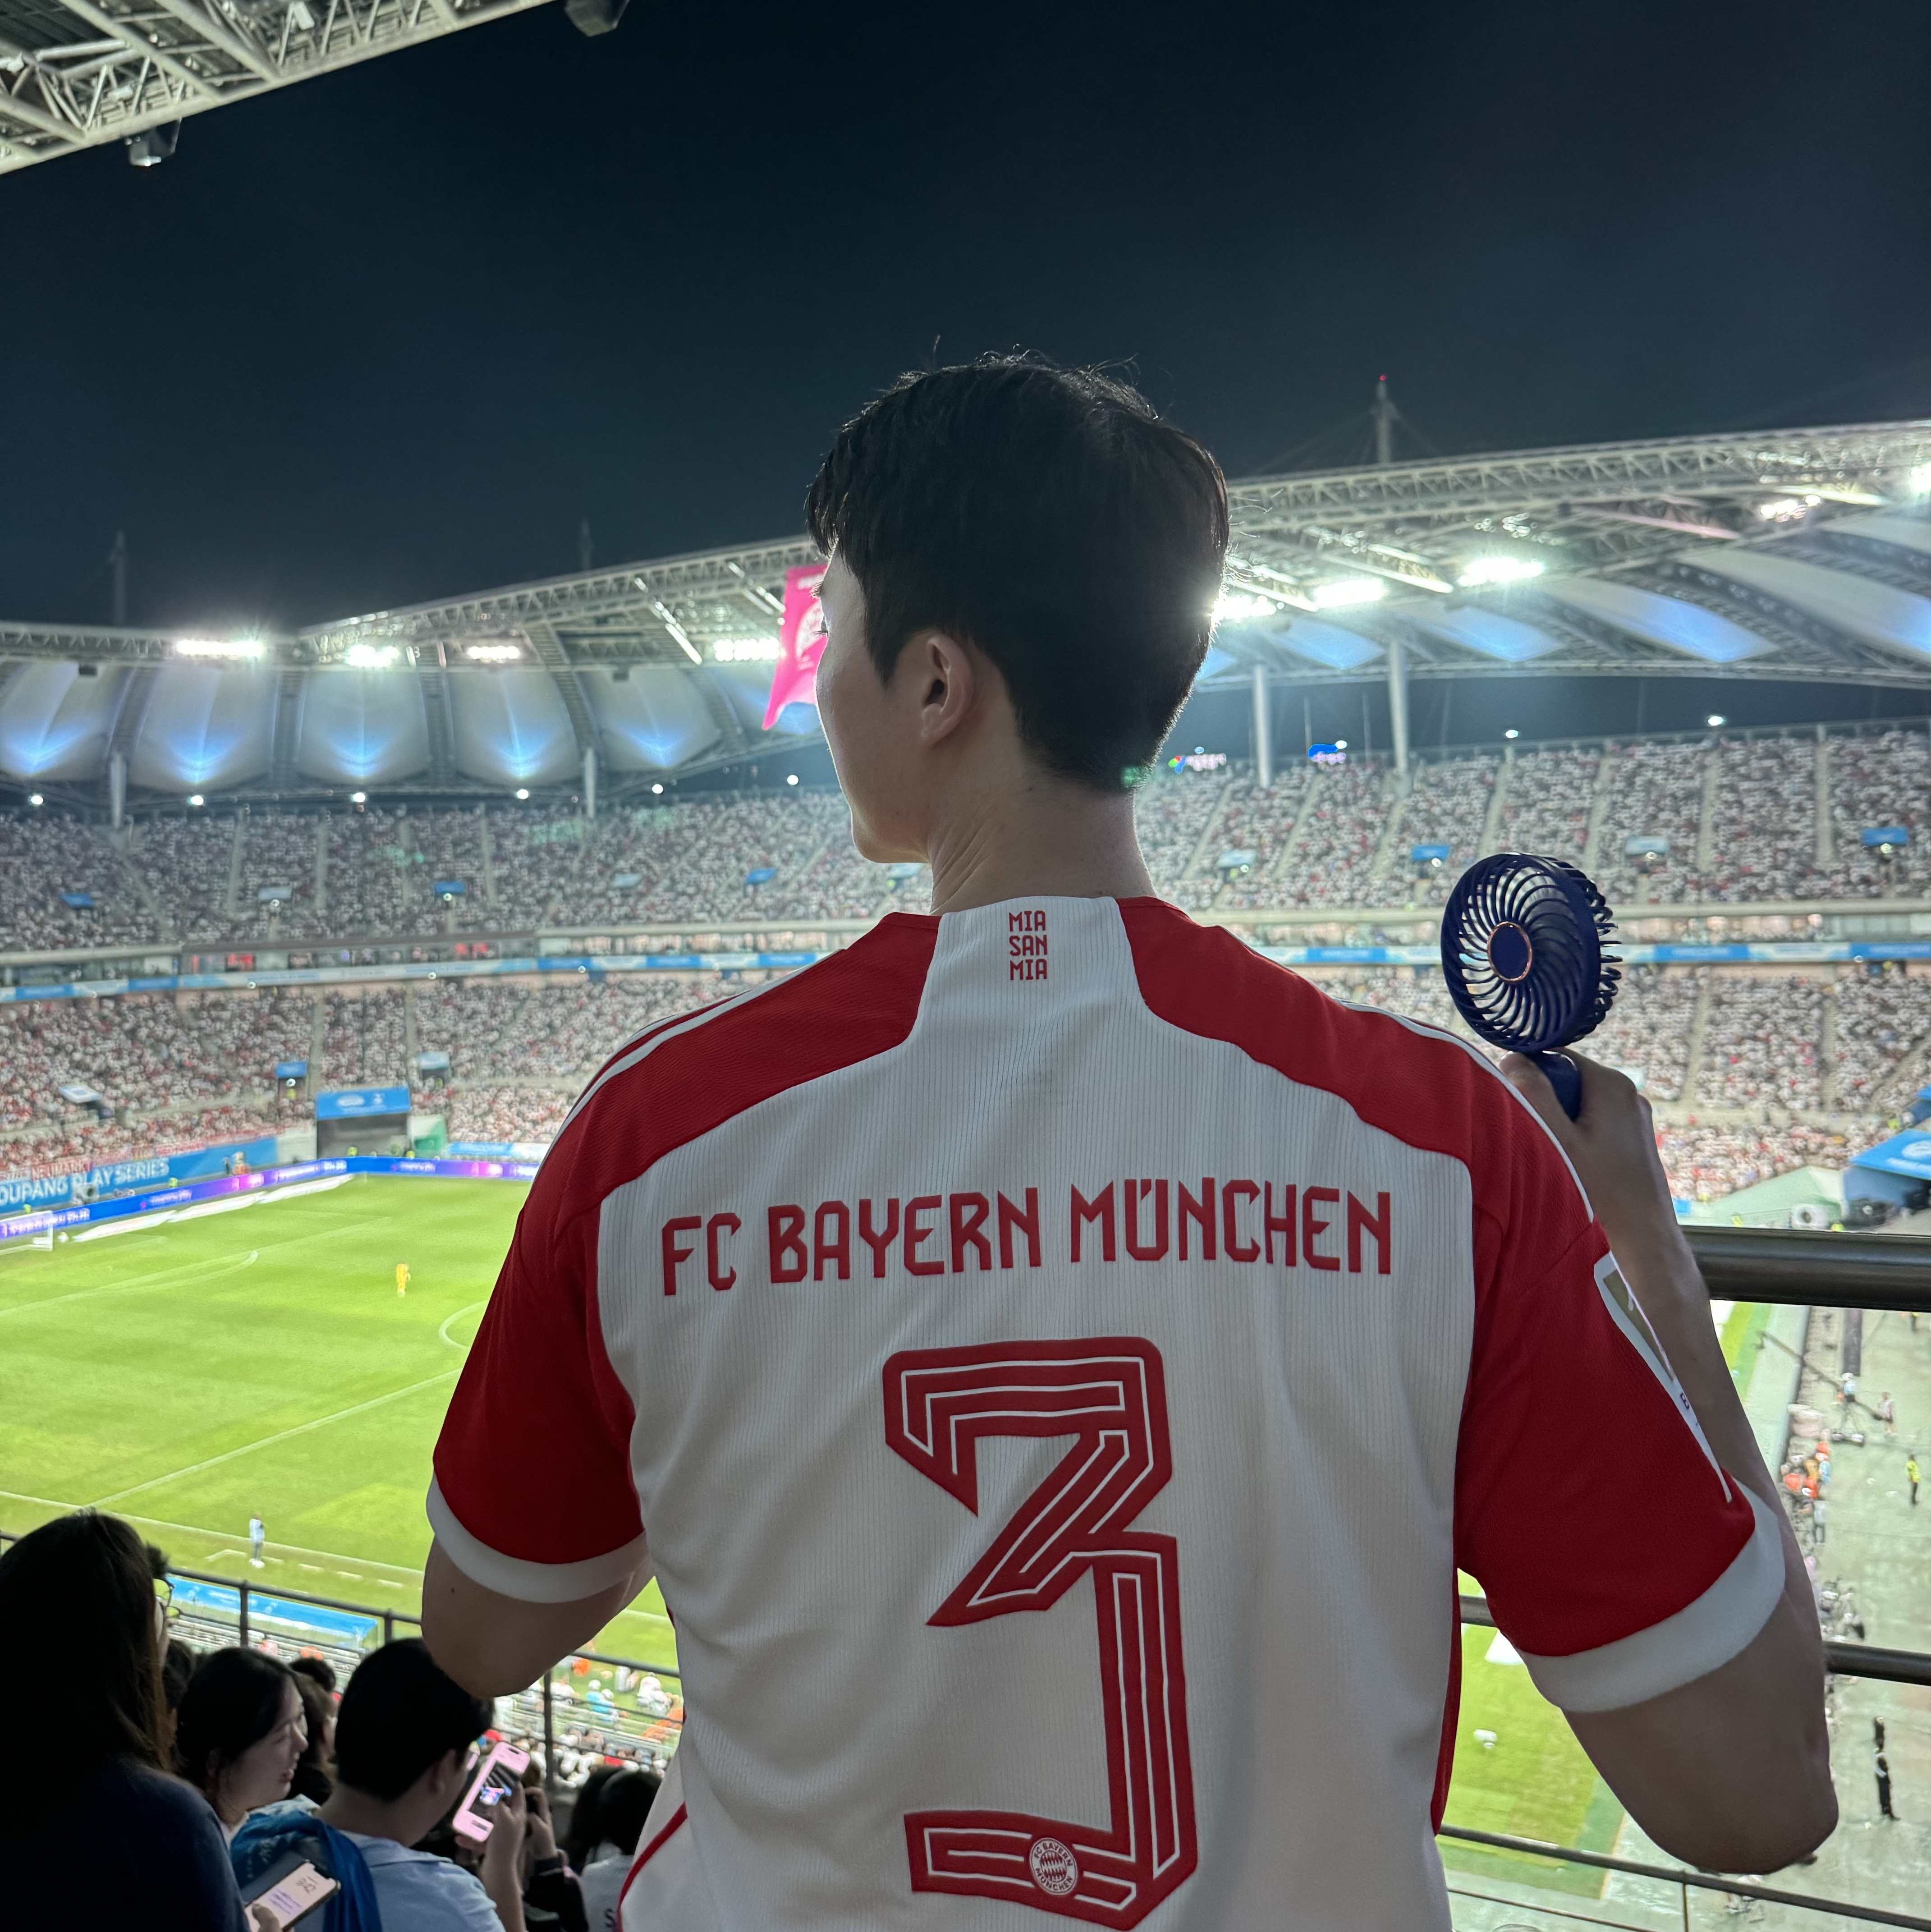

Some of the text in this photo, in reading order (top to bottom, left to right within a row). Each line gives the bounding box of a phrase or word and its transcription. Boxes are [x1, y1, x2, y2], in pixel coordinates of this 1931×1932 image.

[1009, 910, 1046, 932] MIA
[1009, 935, 1048, 956] SAN
[1009, 959, 1047, 981] MIA
[114, 1156, 170, 1185] SERIES
[661, 1177, 1391, 1296] FC BAYERN MÜNCHEN
[882, 1336, 1199, 1932] 3
[1034, 1842, 1073, 1866] FC BAYERN
